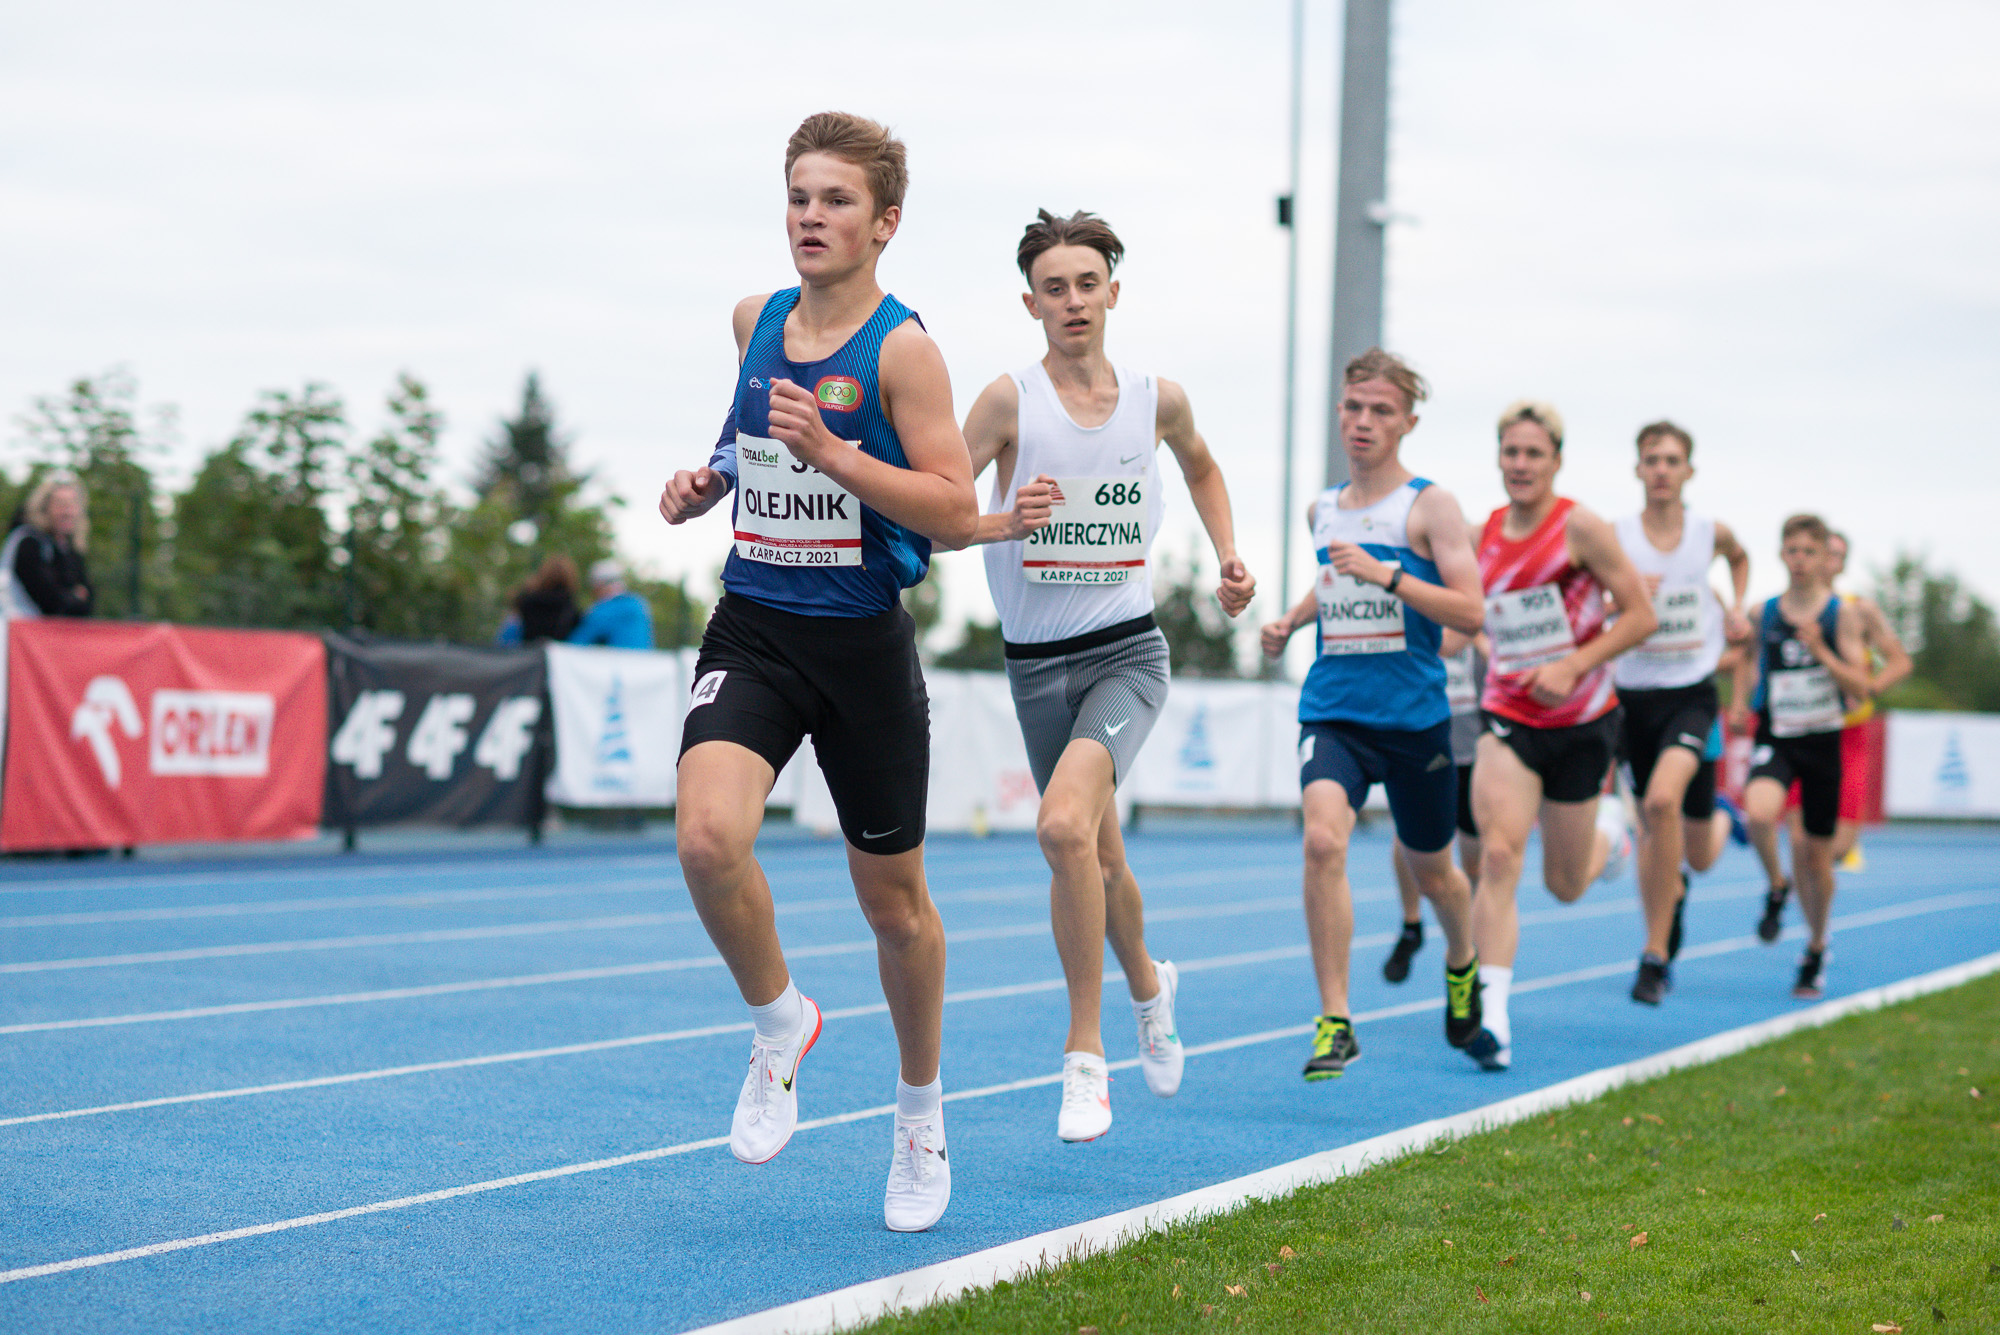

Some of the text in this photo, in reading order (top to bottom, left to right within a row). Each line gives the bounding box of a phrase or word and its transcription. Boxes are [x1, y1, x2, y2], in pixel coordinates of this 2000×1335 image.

[745, 487, 849, 521] OLEJNIK
[1094, 481, 1142, 506] 686
[749, 545, 839, 564] KARPACZ 2021
[1040, 570, 1129, 582] KARPACZ 2021
[696, 676, 719, 699] 4
[331, 689, 543, 782] 4F 4F 4F
